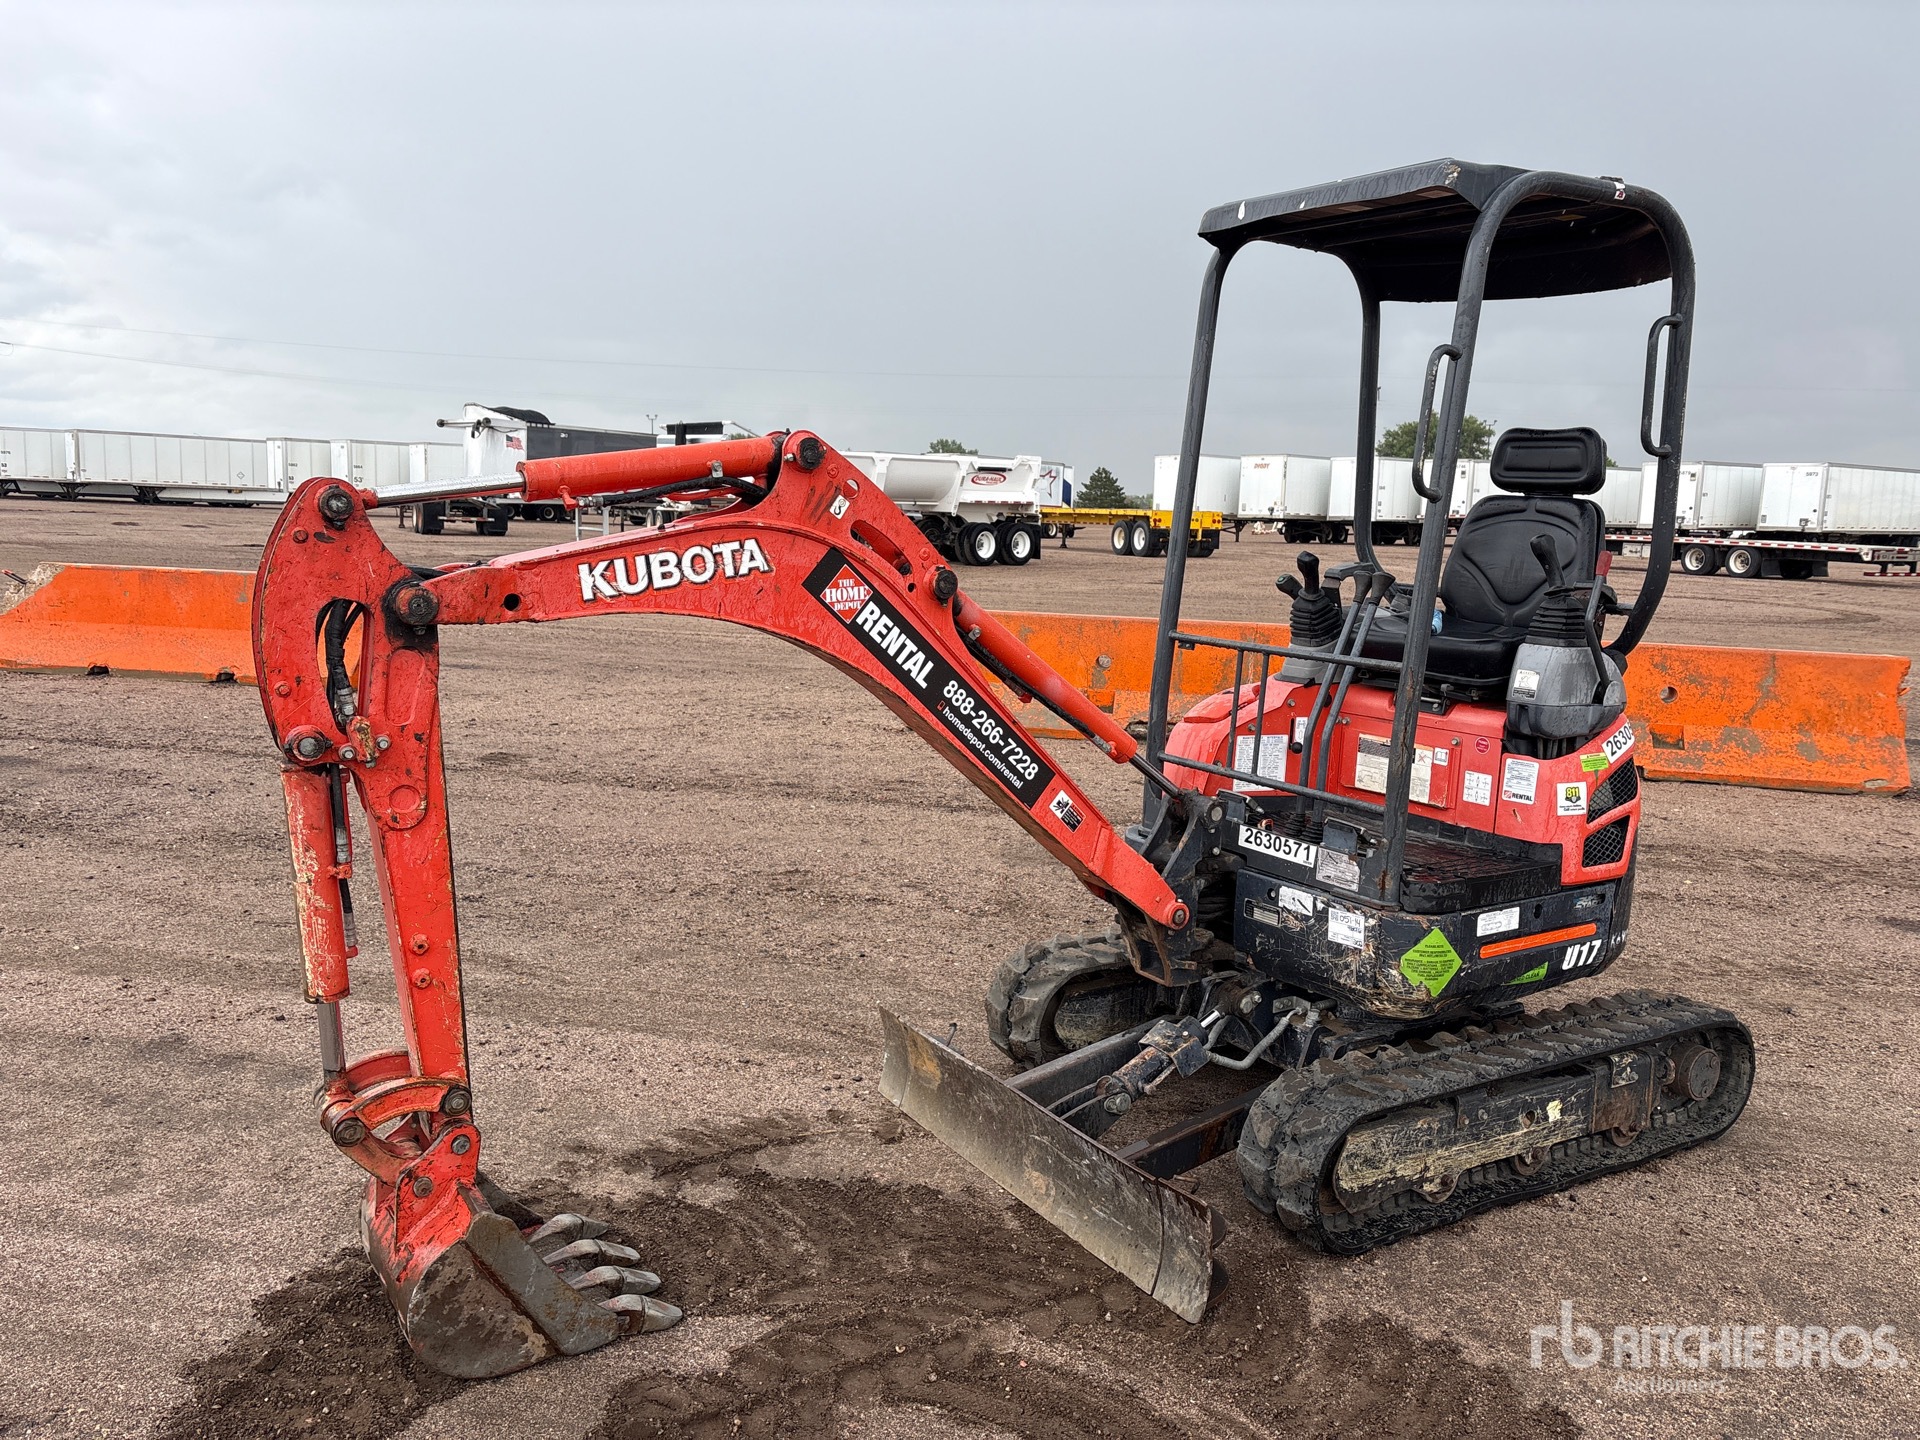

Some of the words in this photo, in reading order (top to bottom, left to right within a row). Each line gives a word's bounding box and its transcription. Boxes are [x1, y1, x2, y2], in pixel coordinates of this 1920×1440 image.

[578, 538, 769, 601] KUBOTA
[825, 585, 870, 603] HOME
[834, 601, 862, 611] DEPOT
[855, 601, 934, 689] RENTAL
[943, 680, 1039, 781] 888-266-7228
[1606, 725, 1634, 757] 2630
[942, 706, 1023, 789] homedepot.com/rental
[1511, 793, 1533, 801] RENTAL
[1566, 786, 1580, 797] 811
[1244, 828, 1311, 861] 2630571
[1562, 939, 1602, 971] U17
